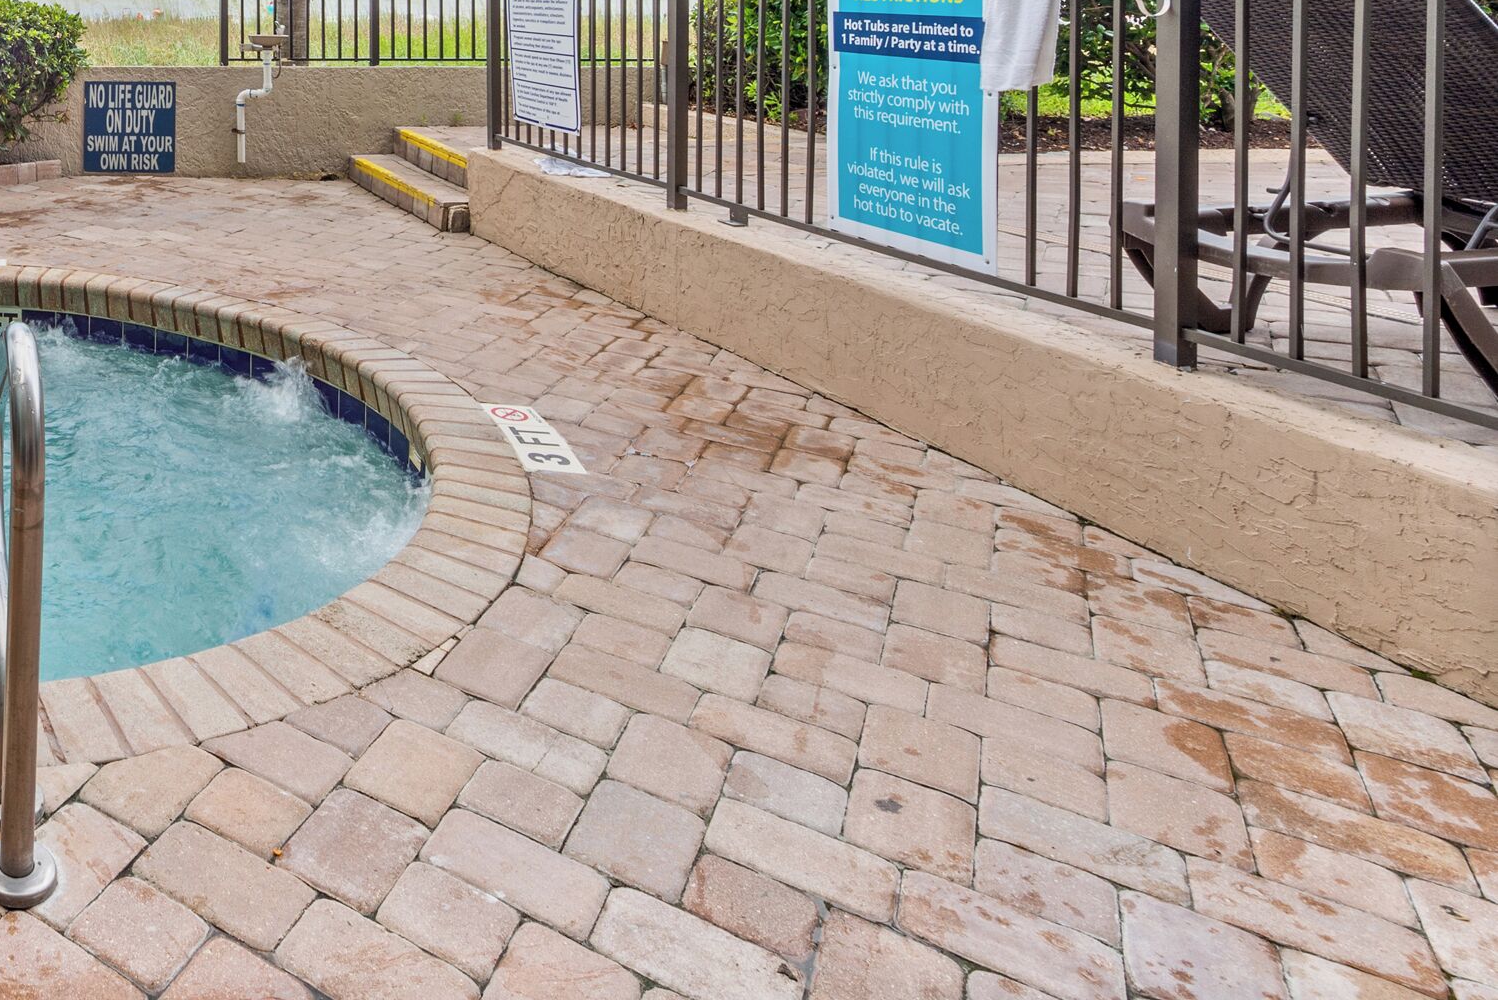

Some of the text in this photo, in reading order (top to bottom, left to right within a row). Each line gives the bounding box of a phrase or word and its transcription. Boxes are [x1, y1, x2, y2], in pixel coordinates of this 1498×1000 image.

[844, 19, 974, 37] Hot Tubs are Limited to
[841, 33, 981, 55] 1 Family / Party at a time.
[89, 84, 173, 109] NO LIFE GUARD
[857, 70, 957, 97] We ask that you
[848, 88, 970, 116] strictly comply with
[106, 109, 156, 134] ON DUTY
[853, 105, 961, 134] this requirement.
[87, 135, 173, 153] SWIM AT YOUR
[100, 153, 159, 171] OWN RISK
[870, 147, 942, 175] If this rule is
[847, 161, 971, 199] violated, we will ask
[858, 182, 956, 215] everyone in the
[853, 194, 963, 236] hot tub to vacate.
[509, 426, 570, 466] 3 FT
